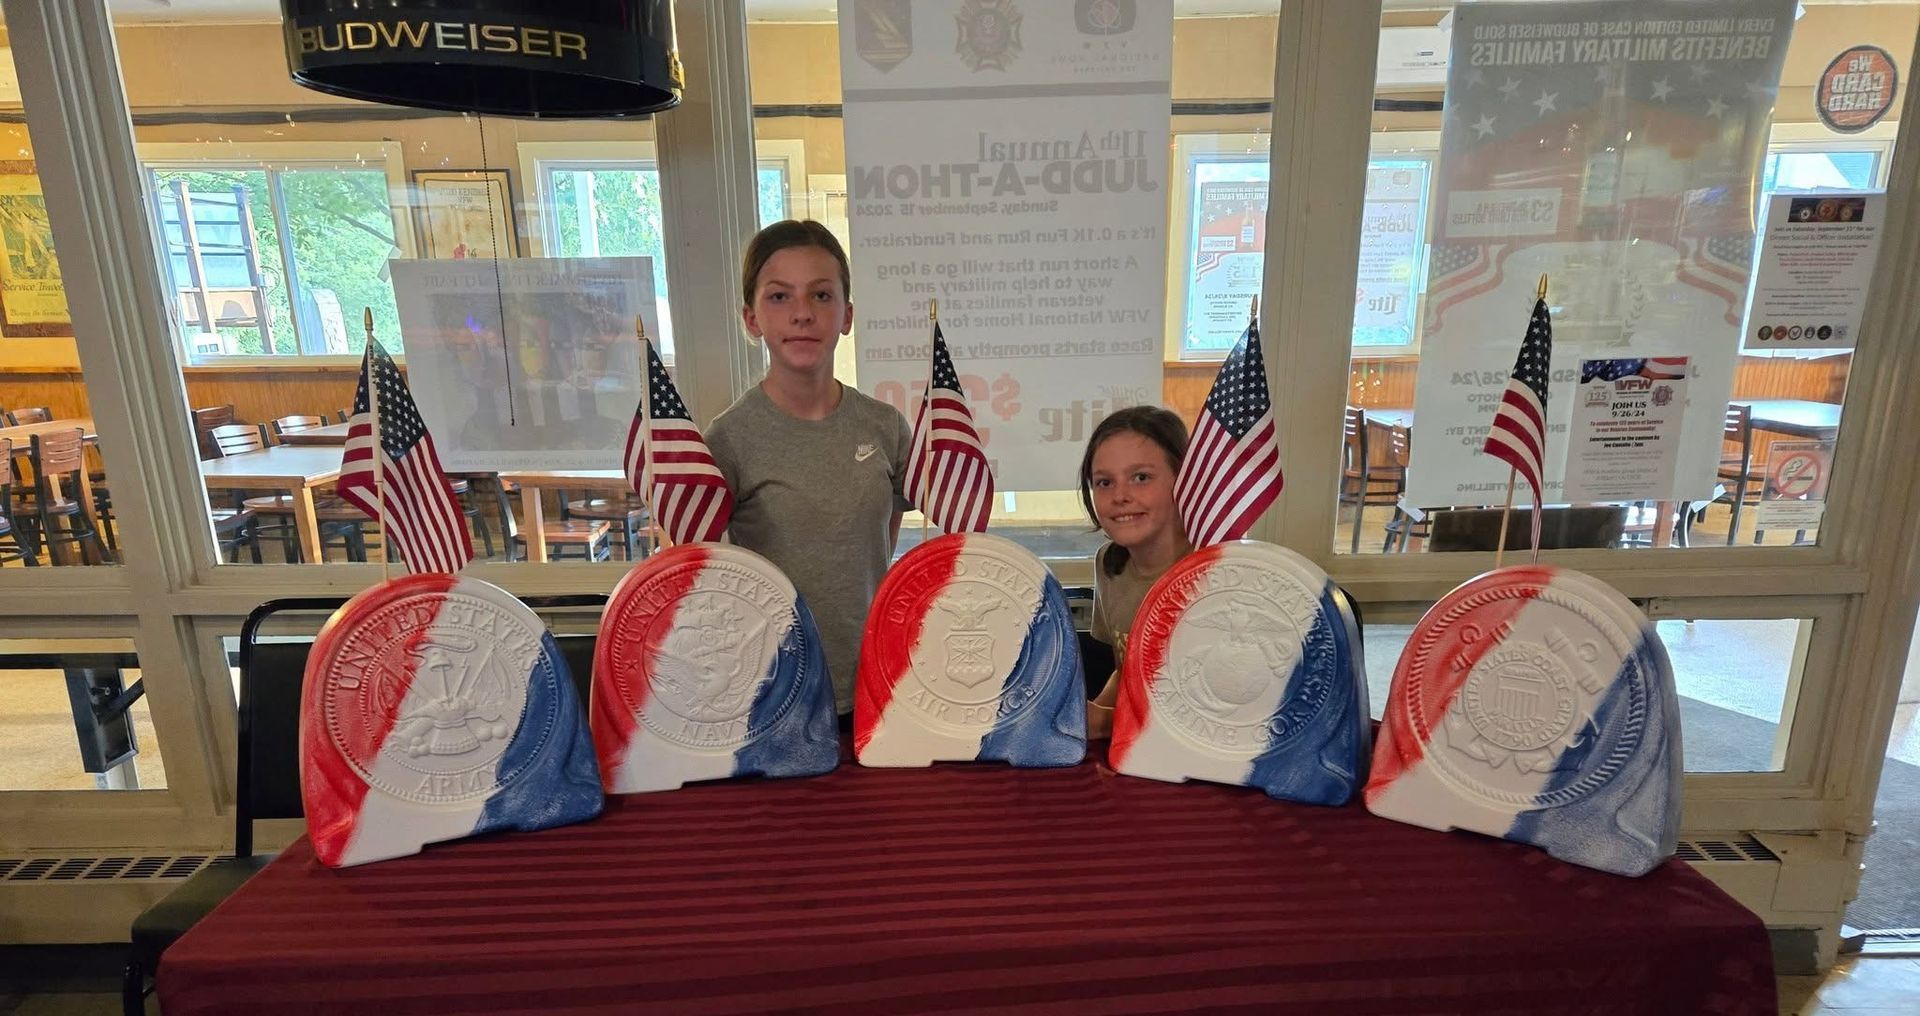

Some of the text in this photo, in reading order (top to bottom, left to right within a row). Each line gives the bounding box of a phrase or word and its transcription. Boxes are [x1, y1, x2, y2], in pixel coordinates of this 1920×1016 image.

[298, 21, 587, 61] BUDWEISER
[1618, 380, 1652, 391] VFW
[1611, 402, 1633, 411] JOIN
[1635, 401, 1647, 409] US
[1612, 410, 1646, 418] 9/26/24
[623, 571, 795, 643] UNITED STATES
[889, 556, 967, 625] UNITED
[1155, 567, 1242, 636] UNITED
[338, 604, 541, 691] UNITED STATES
[908, 685, 1037, 724] AIR FORCE
[680, 716, 752, 741] NAVY
[414, 768, 497, 796] ARMY
